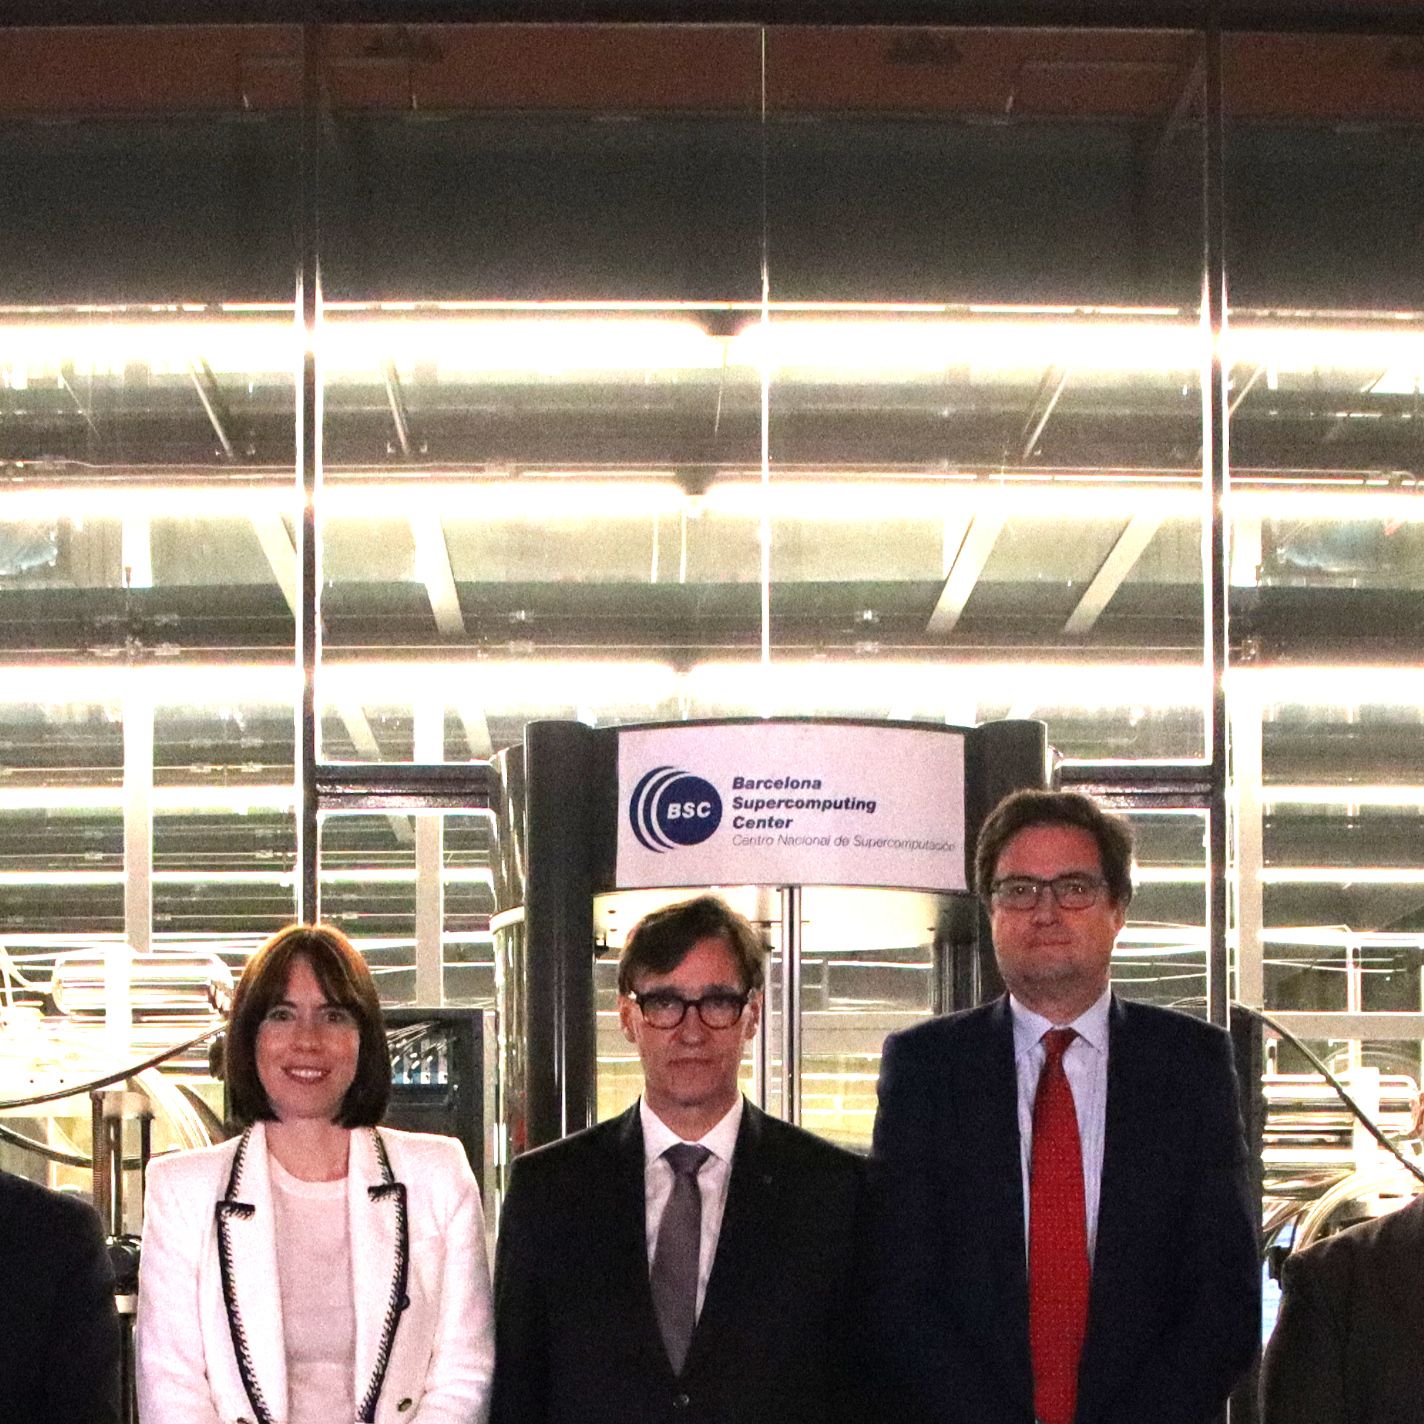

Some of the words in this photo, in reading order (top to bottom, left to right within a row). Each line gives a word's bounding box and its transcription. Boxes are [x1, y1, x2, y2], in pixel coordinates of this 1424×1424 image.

[732, 776, 822, 790] Barcelona
[667, 801, 712, 820] BSC
[732, 796, 877, 814] Supercomputing
[732, 815, 794, 829] Center
[732, 834, 775, 847] Centro
[778, 834, 831, 847] Nacional
[834, 834, 850, 848] de
